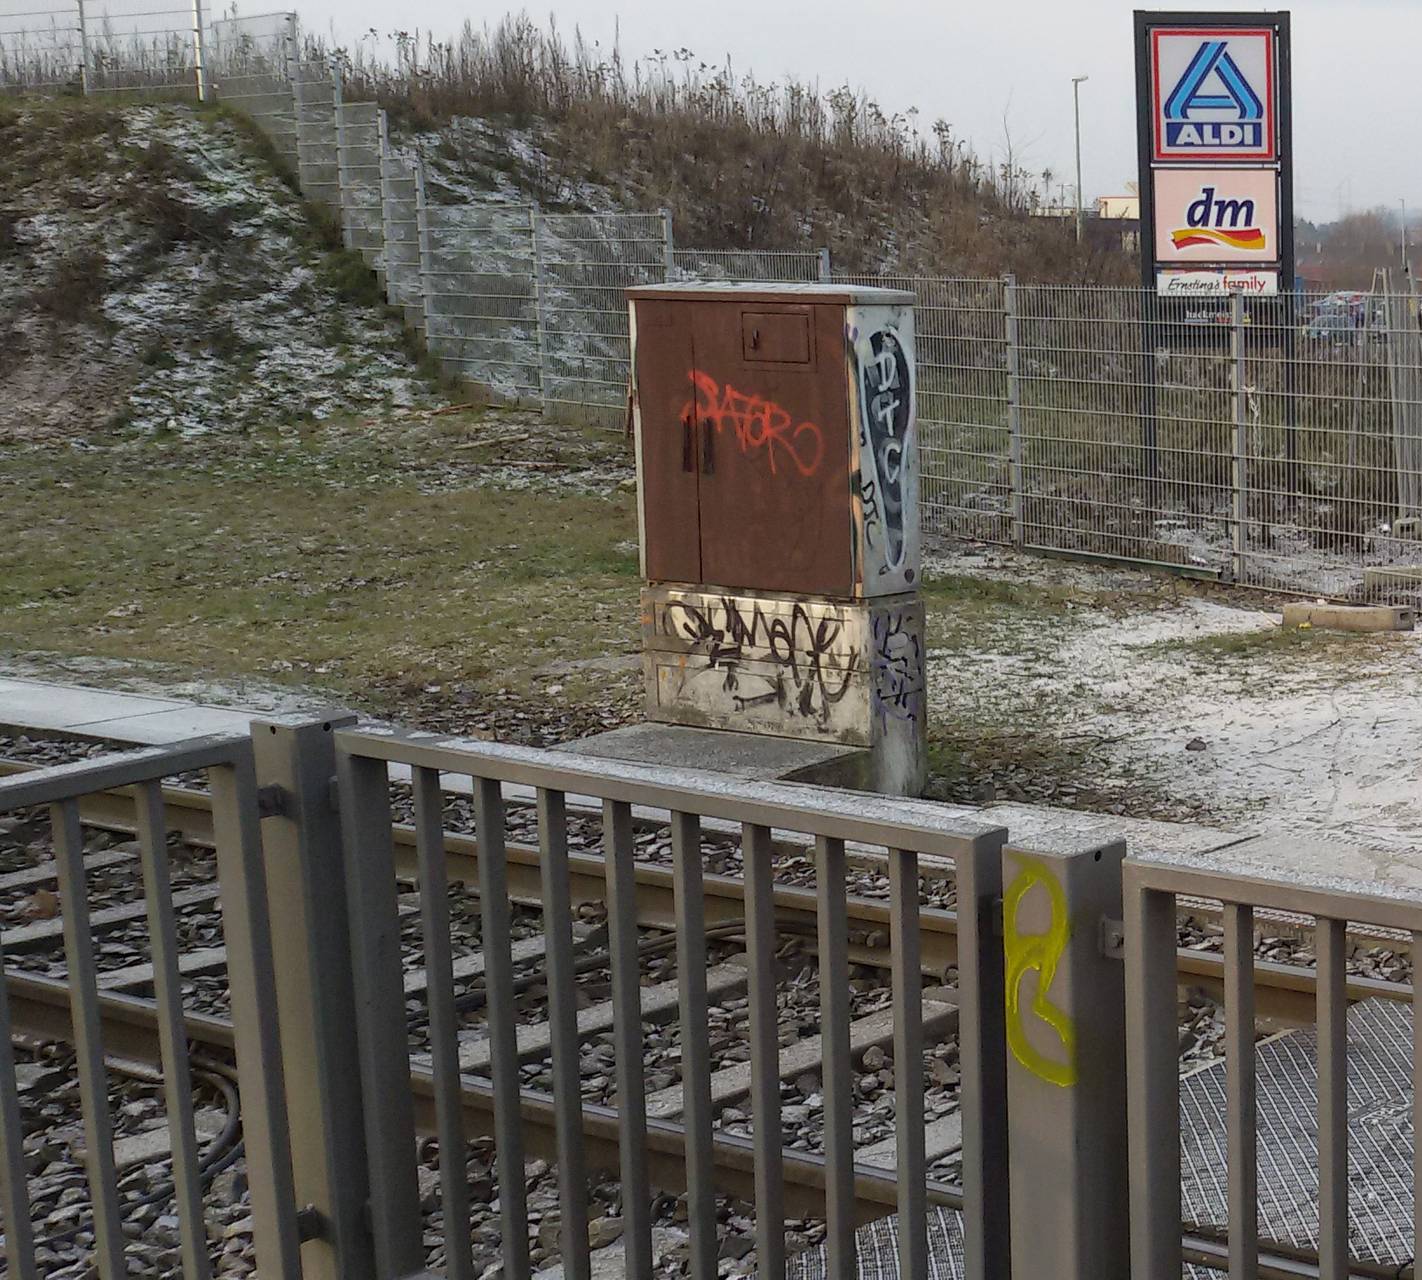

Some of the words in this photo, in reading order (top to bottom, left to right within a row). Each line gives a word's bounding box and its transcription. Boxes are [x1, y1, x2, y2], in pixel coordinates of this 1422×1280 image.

[1176, 124, 1253, 145] ALDI
[1186, 187, 1254, 227] dm
[1168, 278, 1219, 292] Ernsting's
[1223, 275, 1266, 292] family
